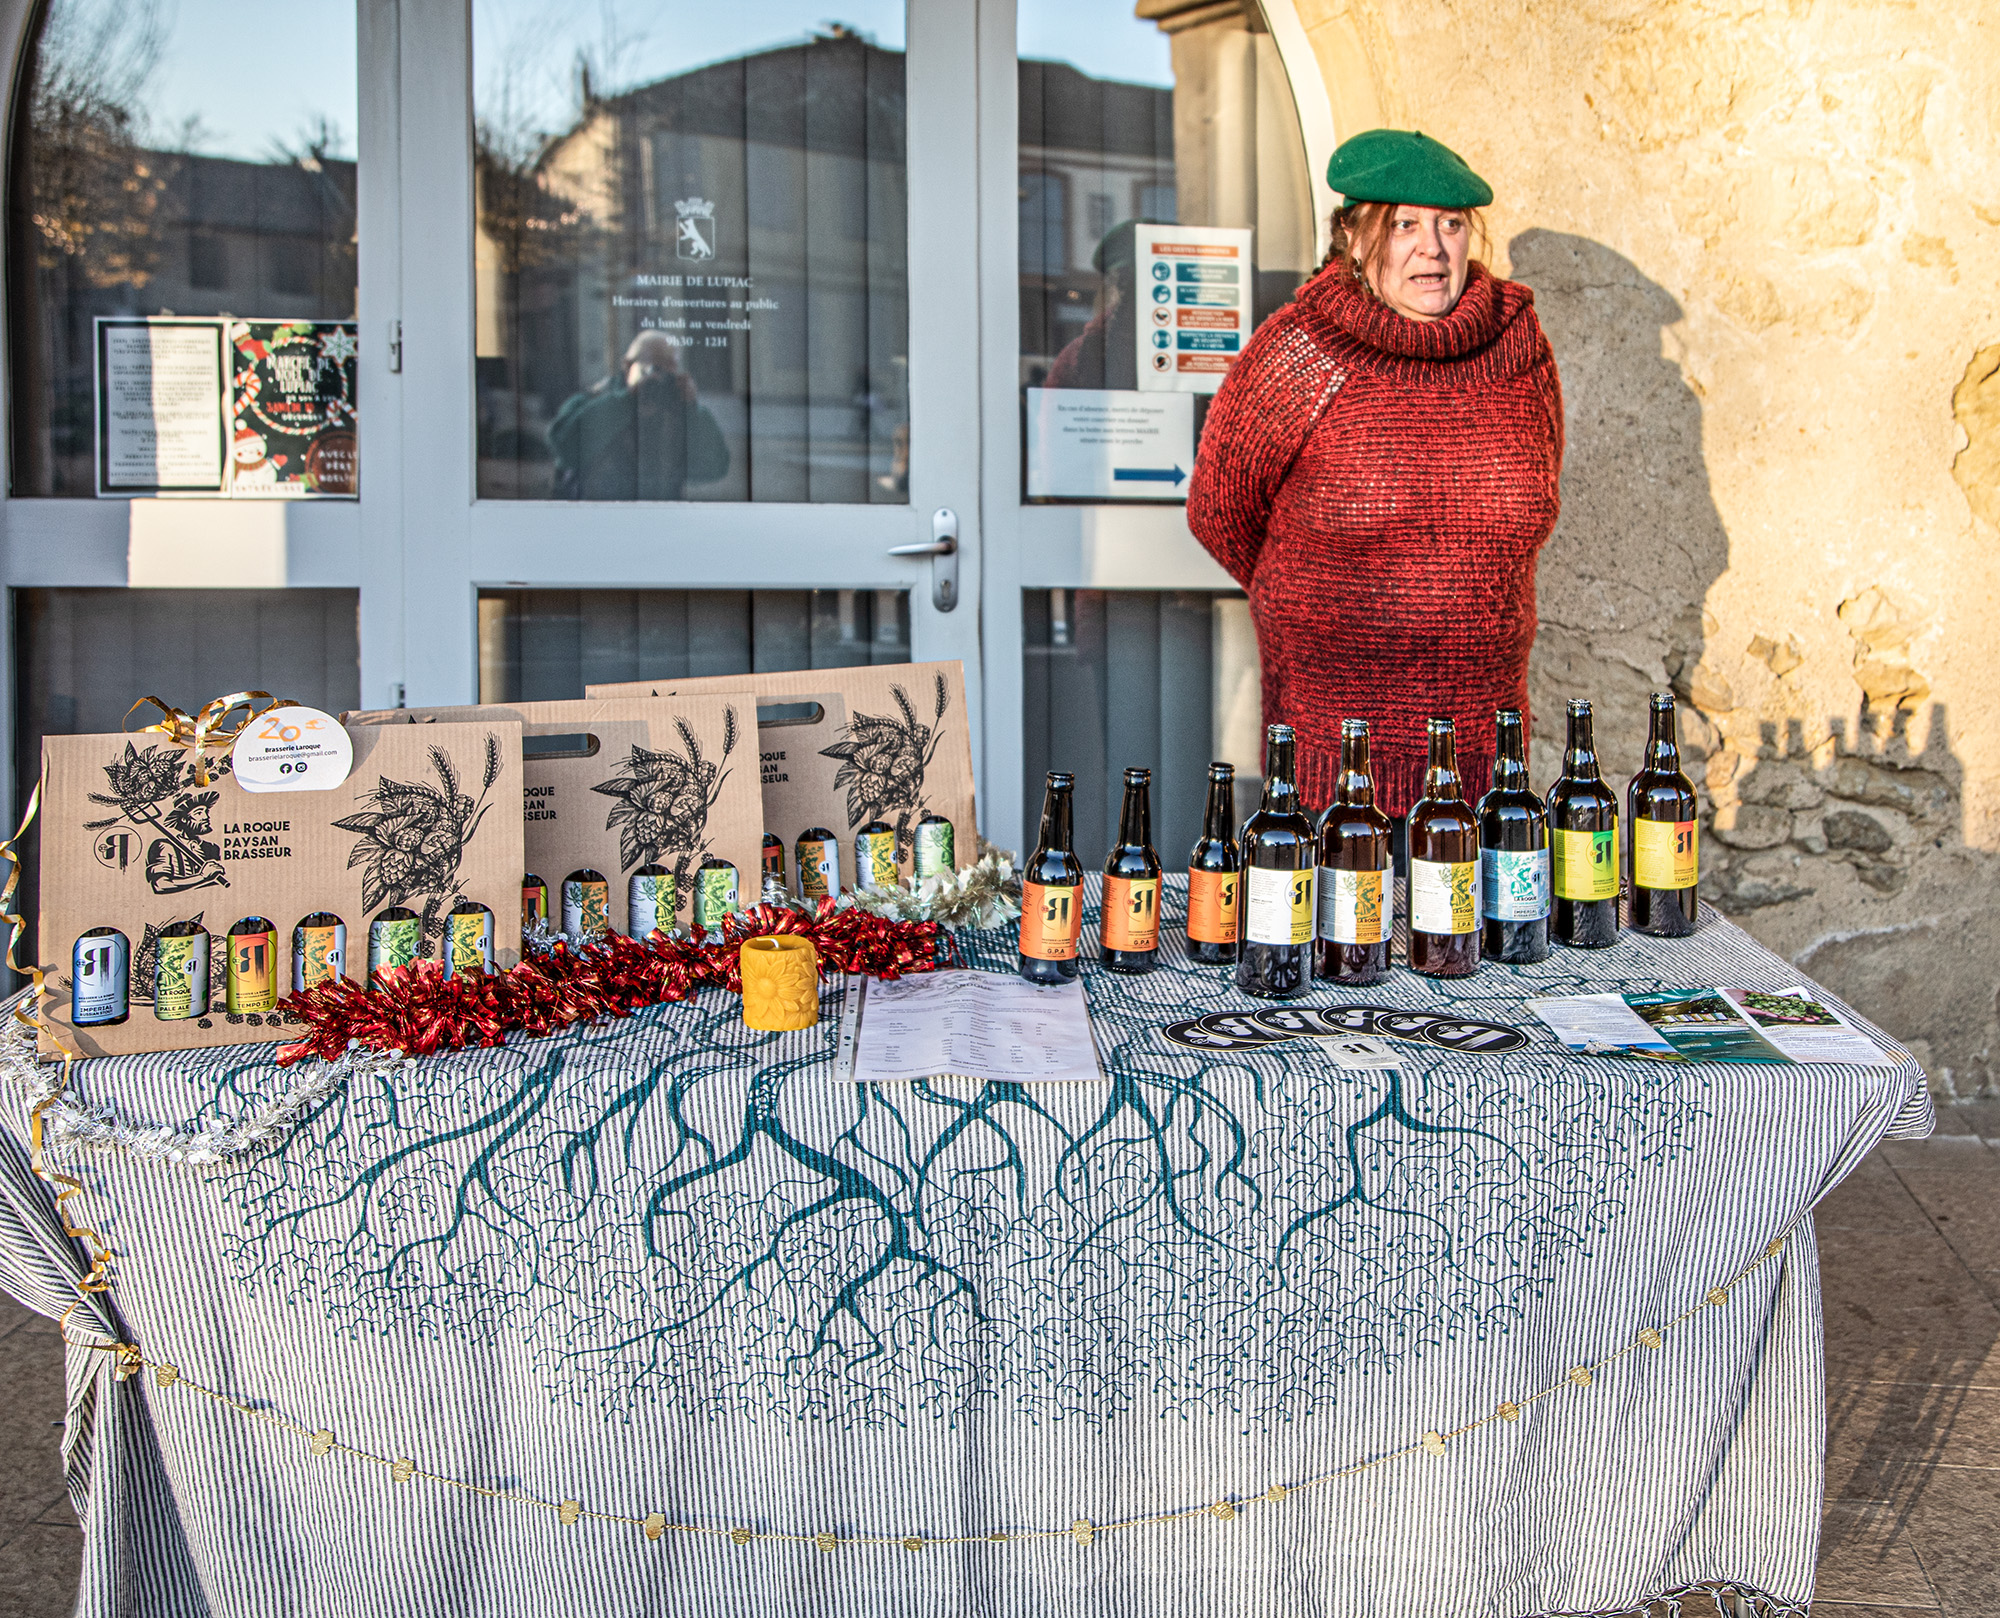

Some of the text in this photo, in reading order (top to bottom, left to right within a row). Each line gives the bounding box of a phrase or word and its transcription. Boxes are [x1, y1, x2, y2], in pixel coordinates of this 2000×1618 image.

[637, 275, 754, 288] MAIRIE DE LUPIAC
[612, 296, 779, 311] Horaires d'ouvertures au public
[640, 317, 654, 328] du
[658, 318, 686, 328] lundi
[705, 319, 751, 330] vendredi
[666, 336, 693, 347] 9h30
[705, 337, 727, 347] 12H
[318, 450, 346, 459] AVEC
[258, 717, 301, 742] 20
[265, 743, 321, 753] Brasserie Laroque
[248, 749, 338, 762] brasserielaroque@gmail.com
[759, 751, 786, 762] OQUE
[524, 786, 555, 797] OQUE
[223, 820, 291, 834] LA ROQUE
[223, 835, 279, 848] PAYSAN
[223, 847, 292, 861] BRASSEUR
[80, 1004, 114, 1012] IMPERIAL
